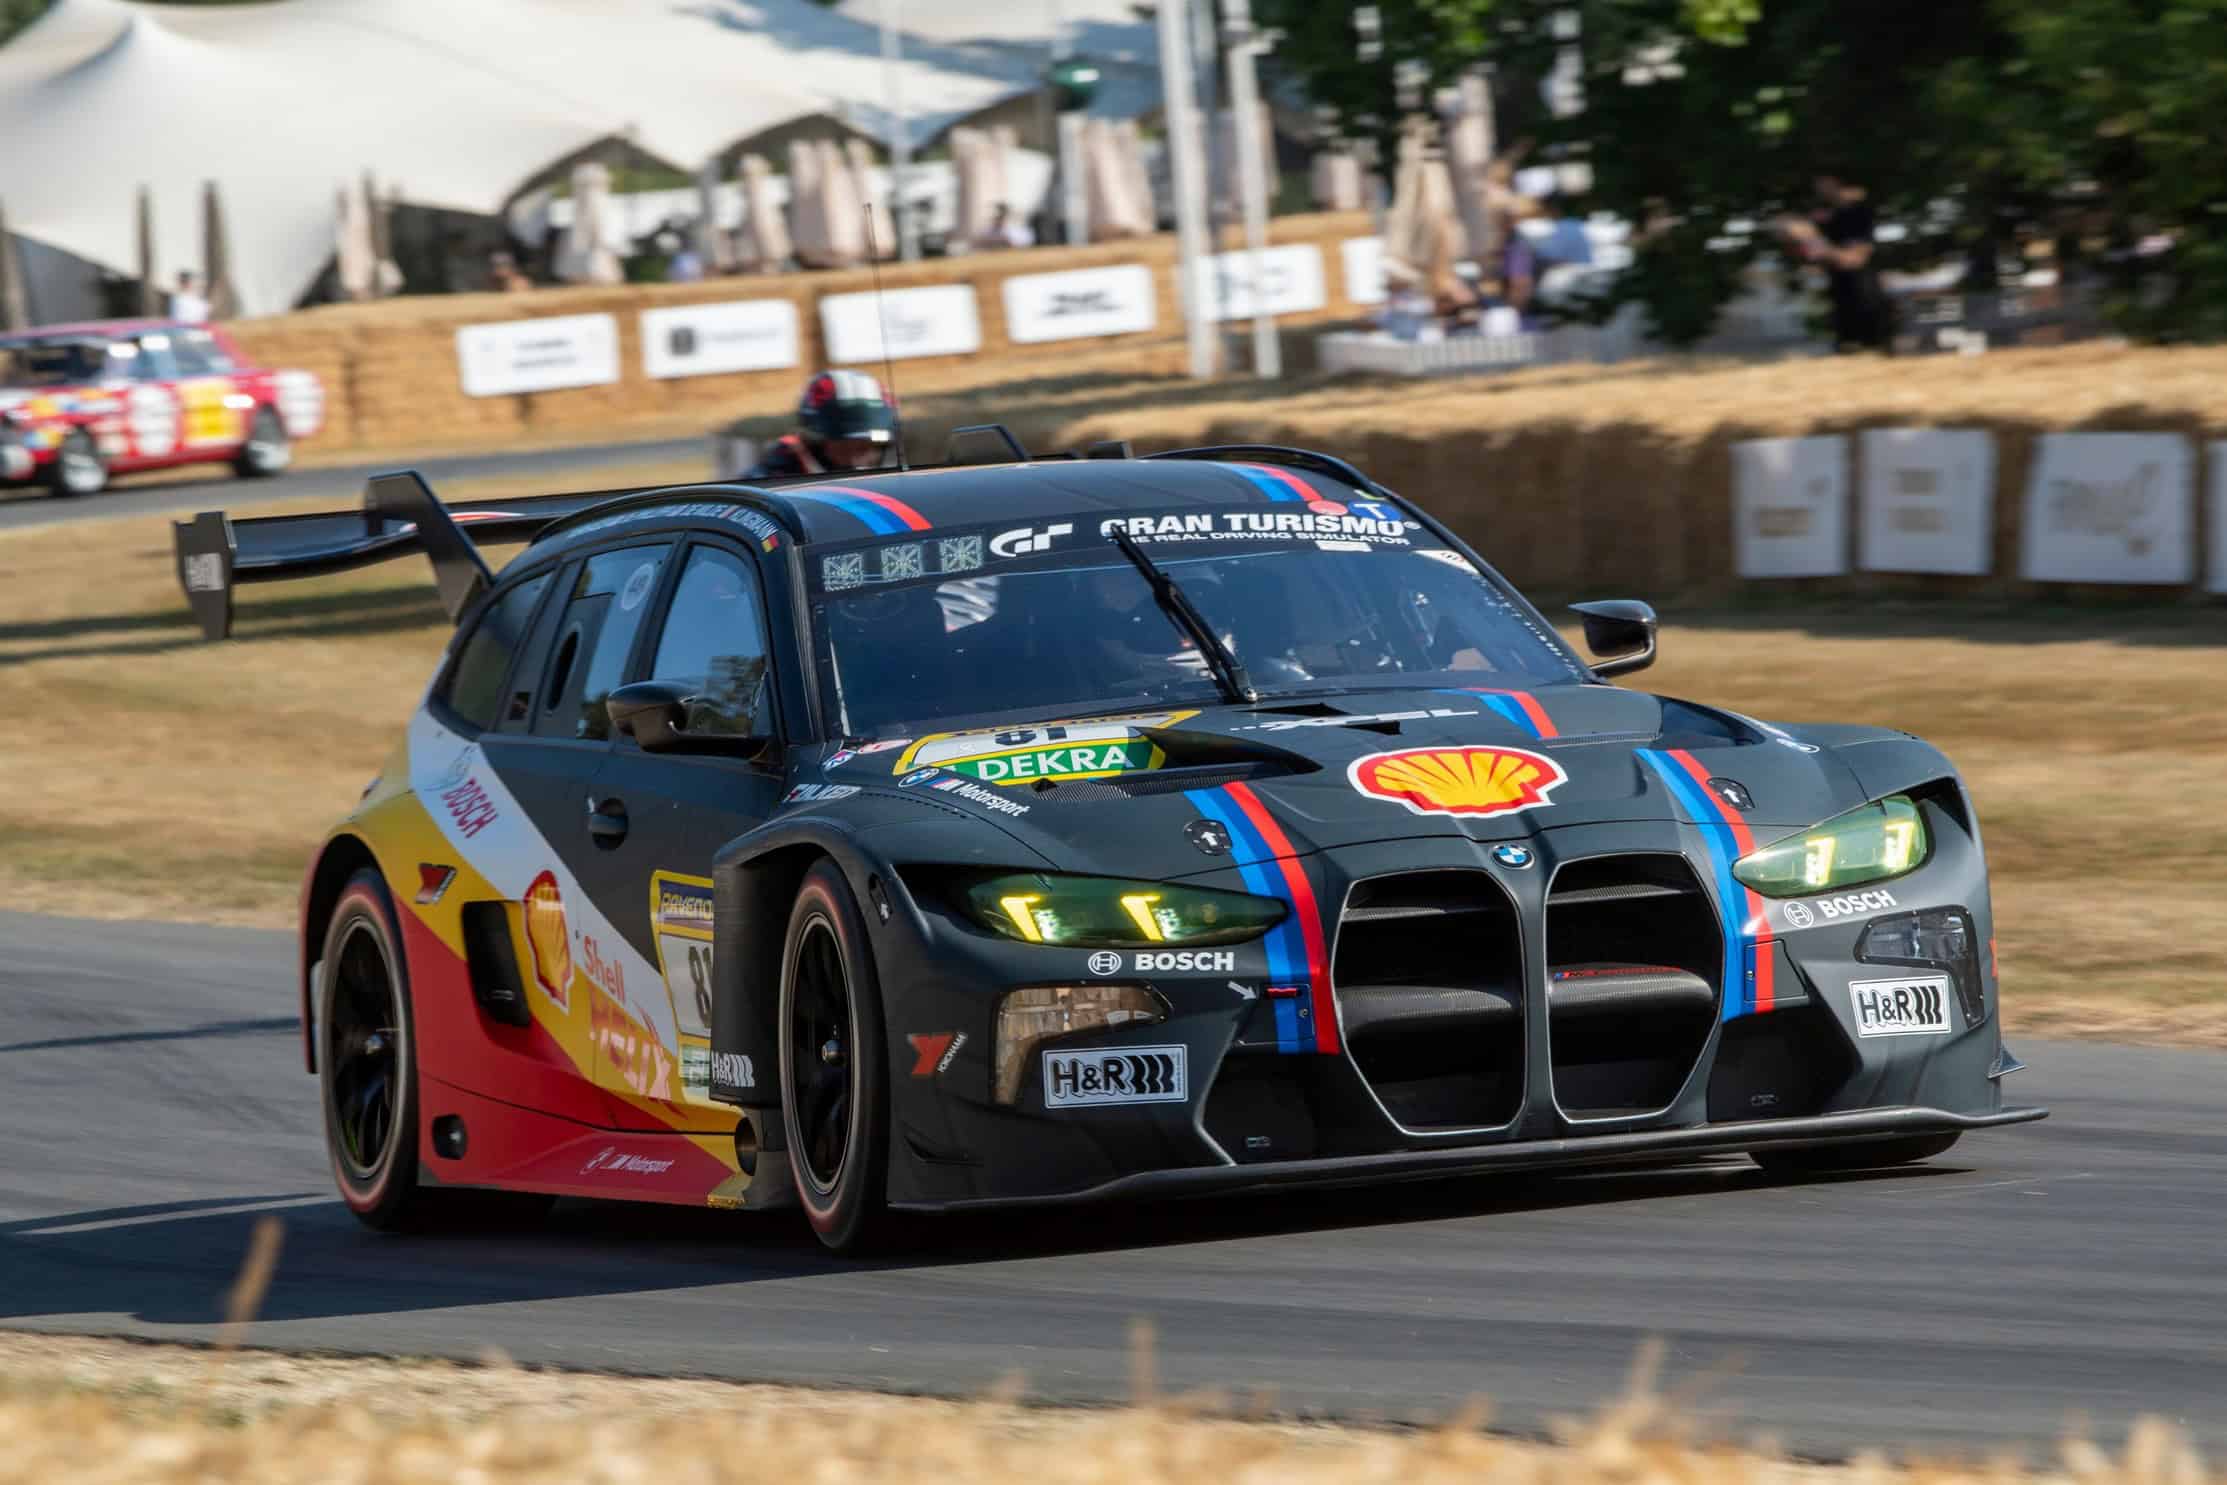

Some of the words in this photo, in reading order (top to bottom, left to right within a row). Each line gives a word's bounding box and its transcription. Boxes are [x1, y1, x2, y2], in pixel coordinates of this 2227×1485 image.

[1100, 514, 1213, 538] GRAN
[1223, 513, 1405, 537] TURISMO
[1153, 531, 1209, 543] REAL
[1210, 530, 1292, 541] DRIVING
[1293, 531, 1411, 546] SIMULATOR
[977, 745, 1136, 781] DEKRA
[440, 776, 499, 839] BOSCH
[952, 782, 1032, 817] Motorsport
[1817, 889, 1897, 919] BOSCH
[1135, 951, 1236, 972] BOSCH
[1857, 986, 1918, 1028] H&R
[1051, 1056, 1132, 1099] H&R
